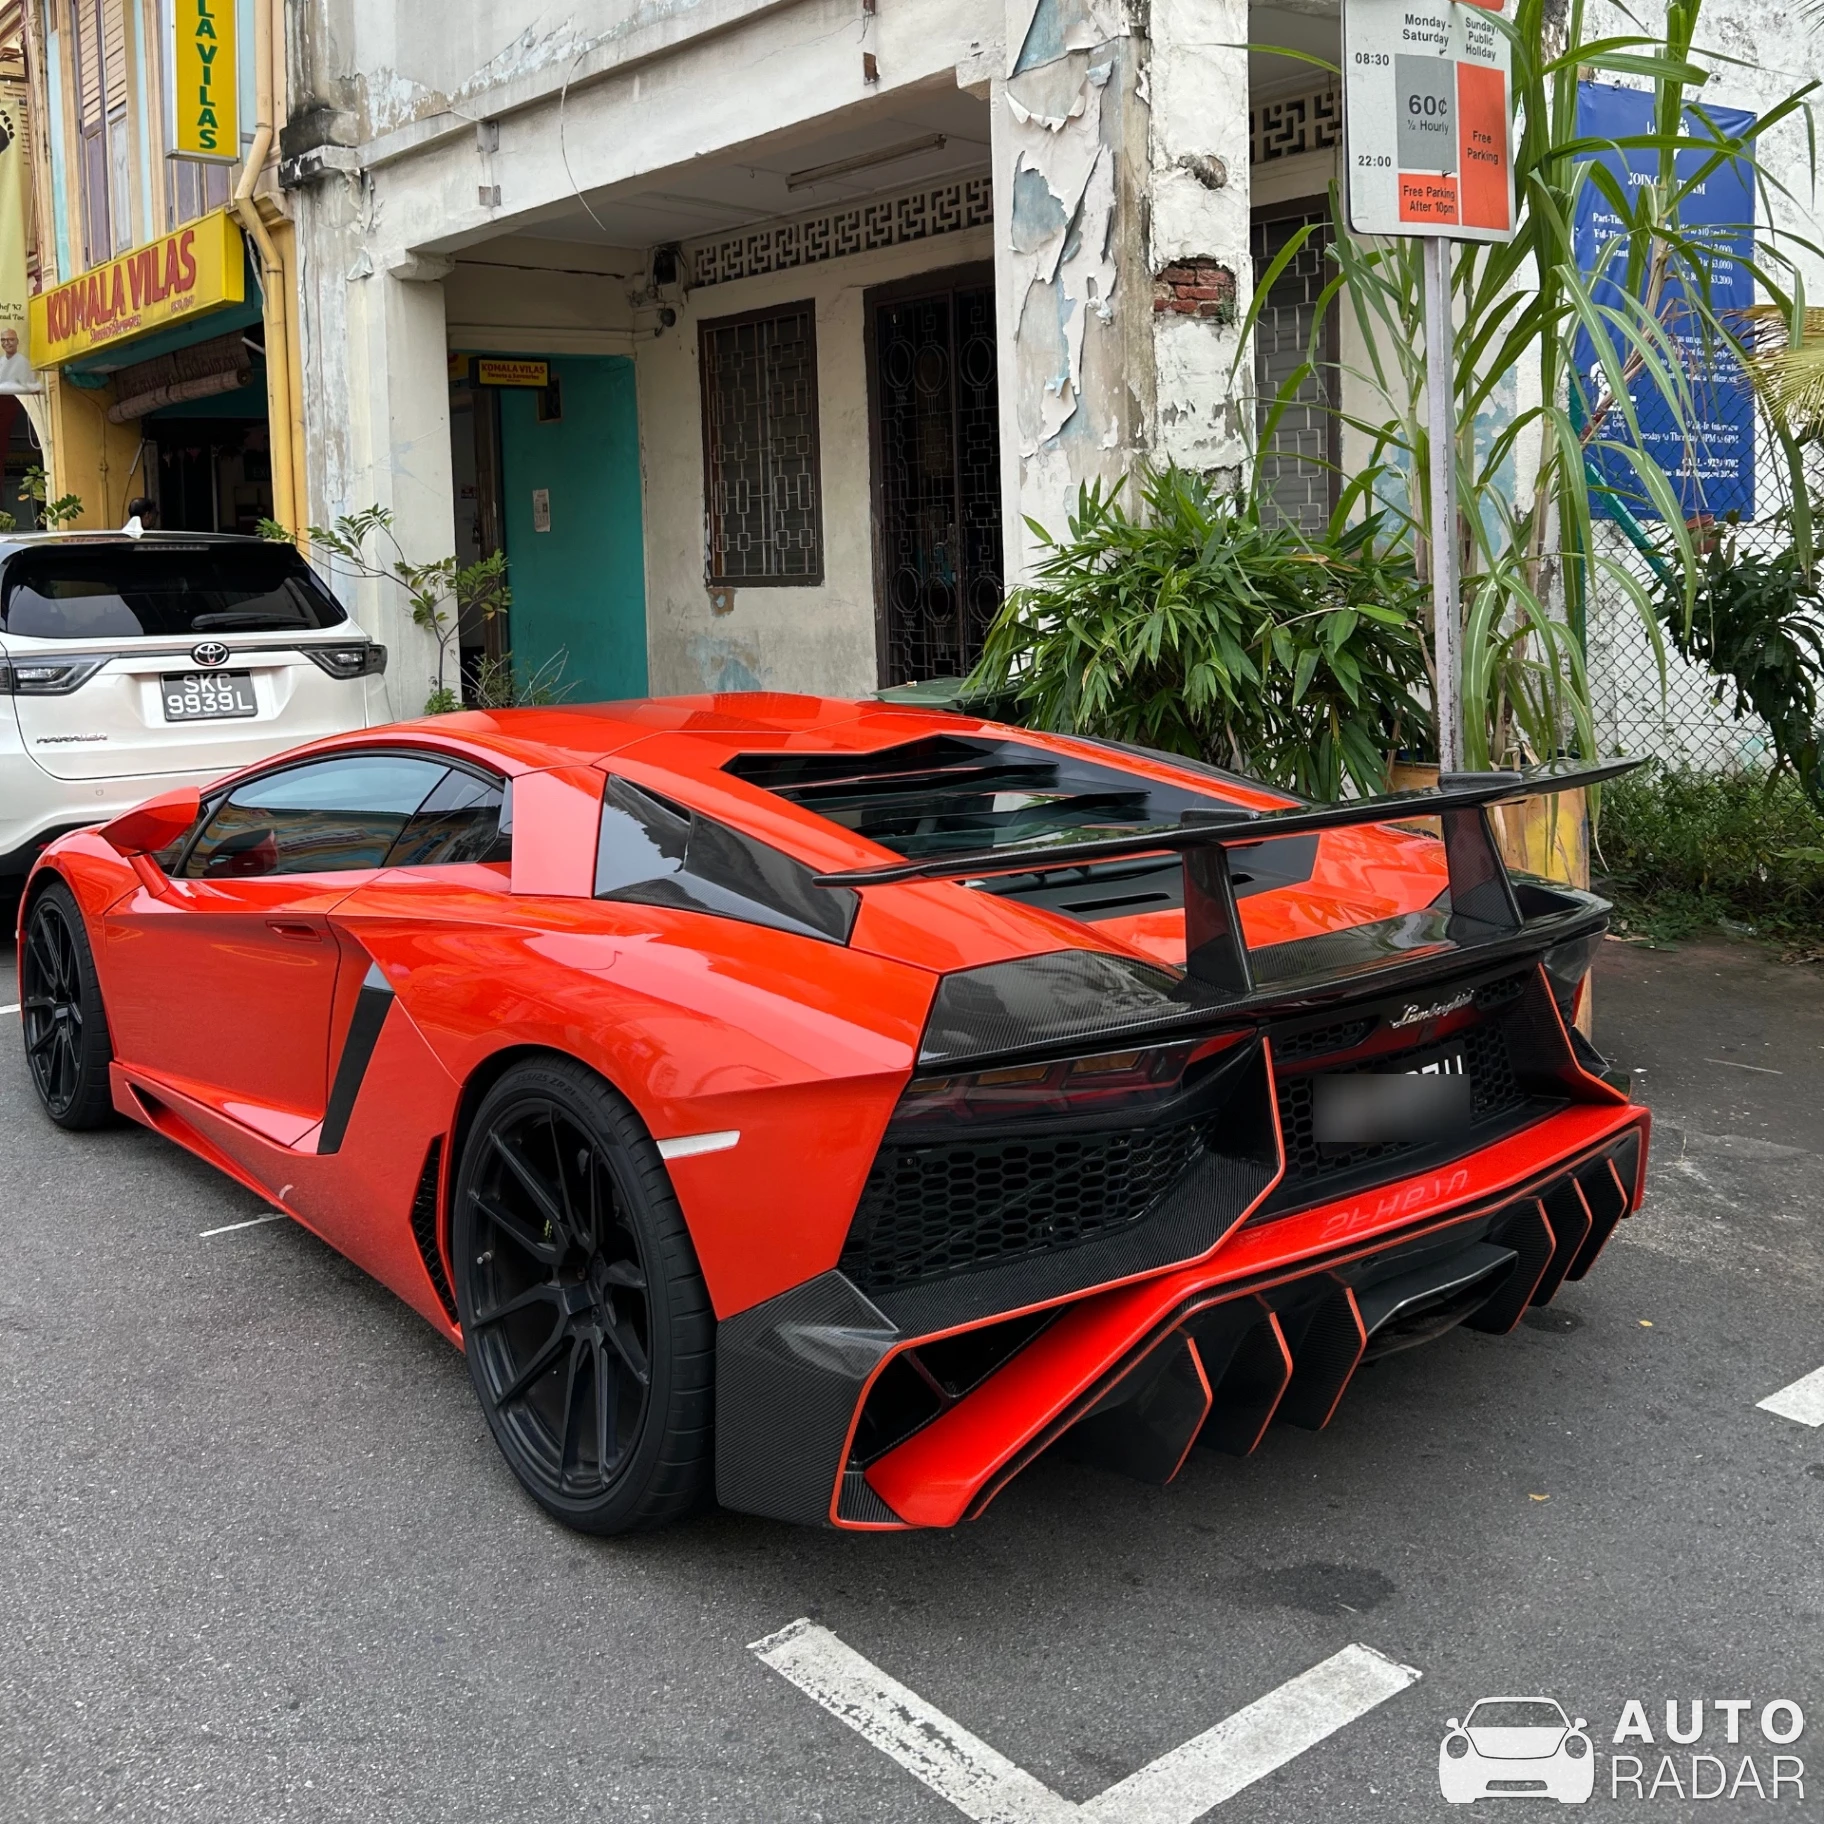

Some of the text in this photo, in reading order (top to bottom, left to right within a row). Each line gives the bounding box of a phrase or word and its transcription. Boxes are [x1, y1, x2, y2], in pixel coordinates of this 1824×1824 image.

[1405, 14, 1446, 31] Monday
[1402, 29, 1449, 47] Saturday
[1468, 31, 1494, 46] Public
[1355, 52, 1389, 66] 08:30
[1465, 44, 1496, 61] Holiday
[1408, 94, 1448, 117] 60¢
[1420, 120, 1449, 136] Hourly
[1473, 130, 1492, 144] Free
[1358, 155, 1391, 167] 22:00
[1467, 147, 1499, 166] Parking
[1627, 172, 1652, 186] JOIN
[1403, 184, 1455, 202] Free Parking
[1410, 200, 1455, 216] After 10pm
[47, 229, 197, 344] KOMALA VILAS
[481, 363, 545, 374] KOMALA VILAS
[183, 672, 233, 694] SKC
[167, 690, 254, 714] 9939L
[1389, 987, 1475, 1029] Lamborghini
